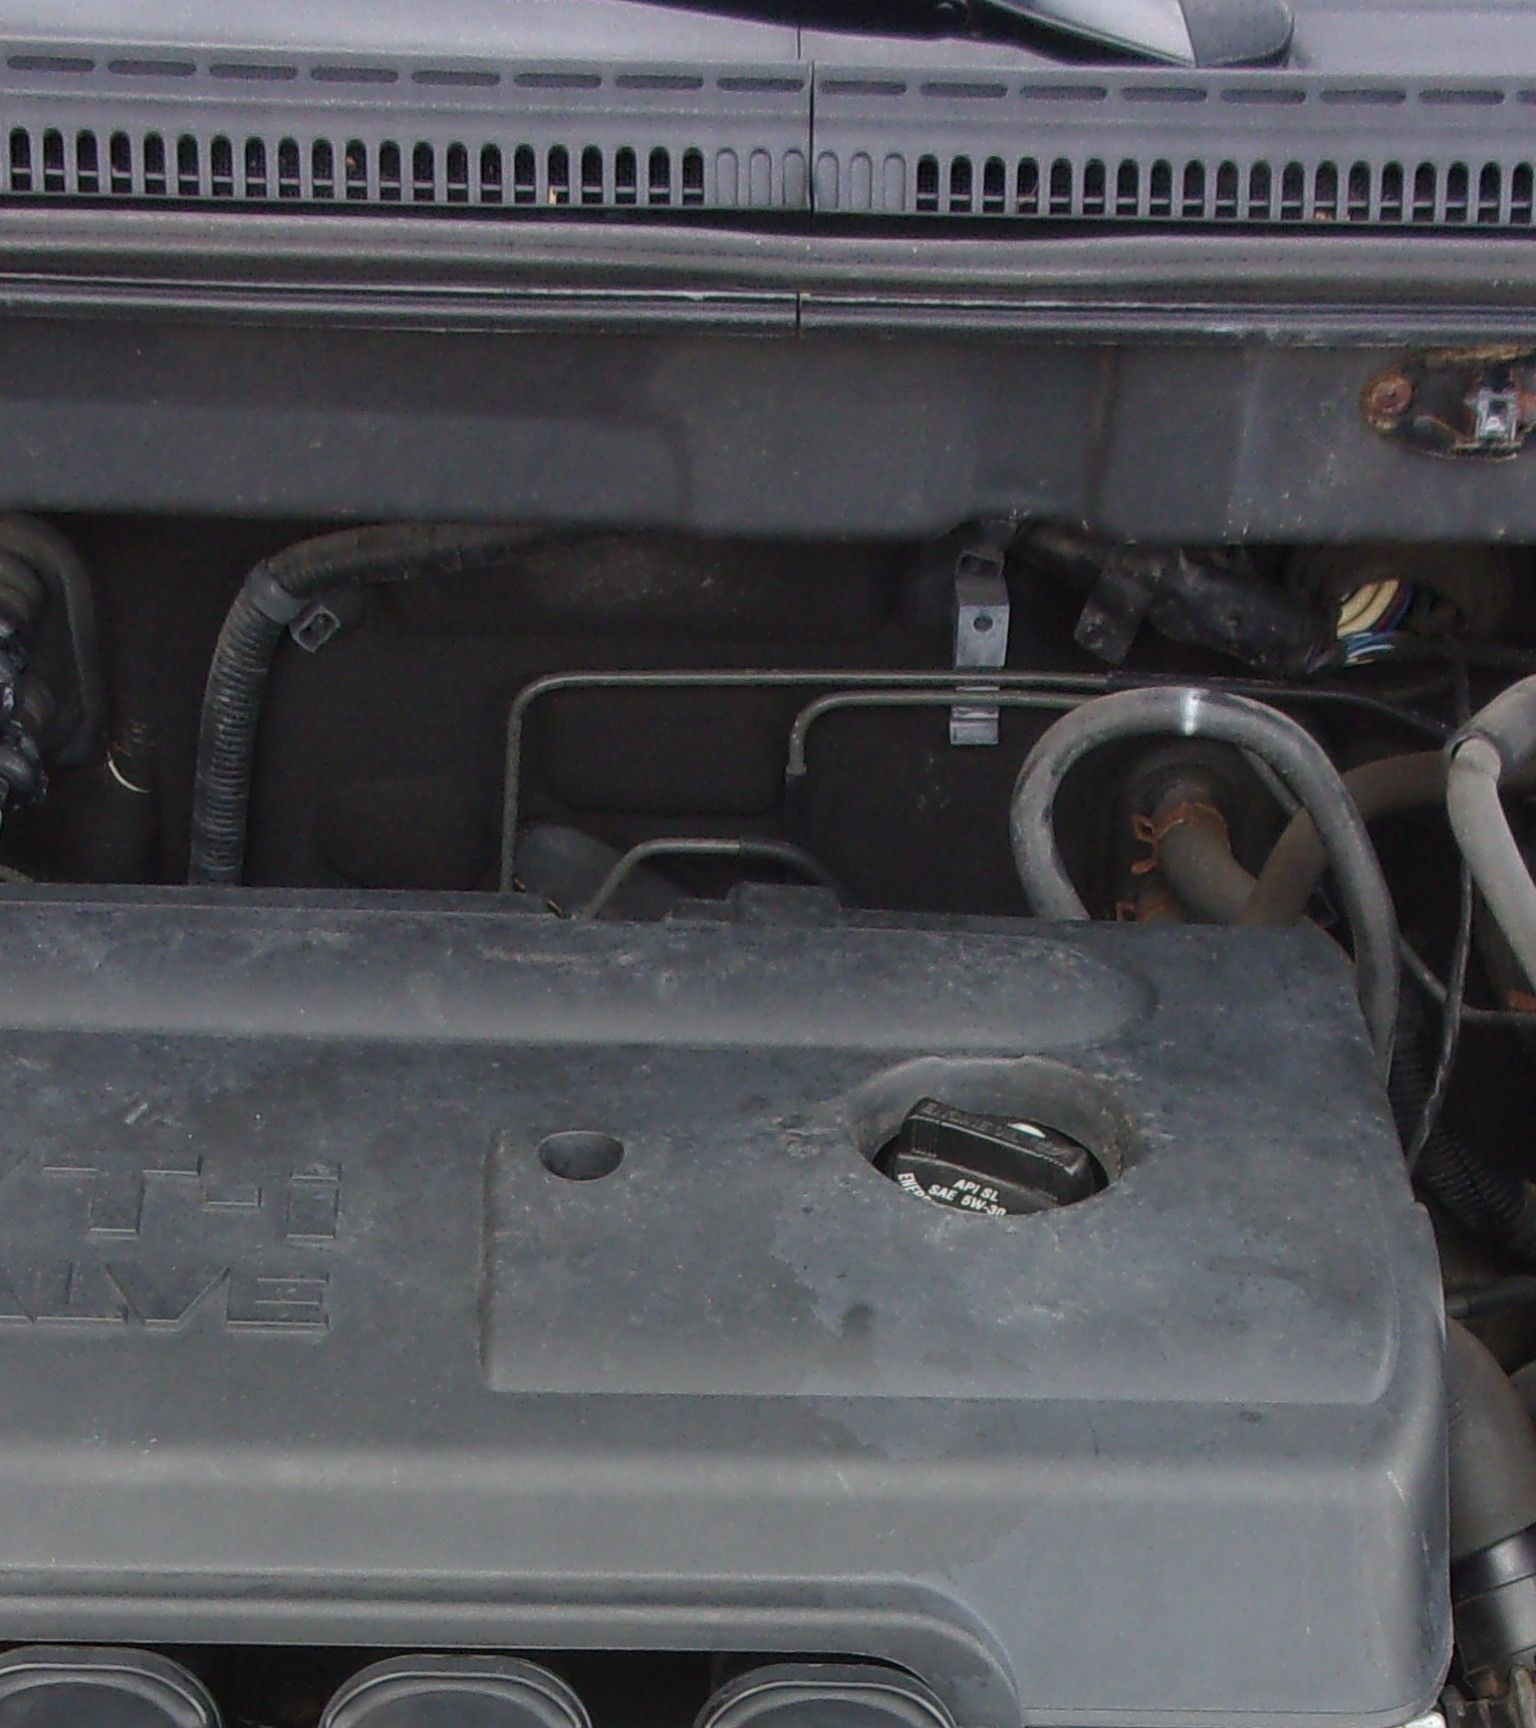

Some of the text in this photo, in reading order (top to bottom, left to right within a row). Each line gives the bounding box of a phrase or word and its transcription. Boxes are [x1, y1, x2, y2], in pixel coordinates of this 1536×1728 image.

[928, 1184, 956, 1204] SAE
[952, 1178, 999, 1204] API SL
